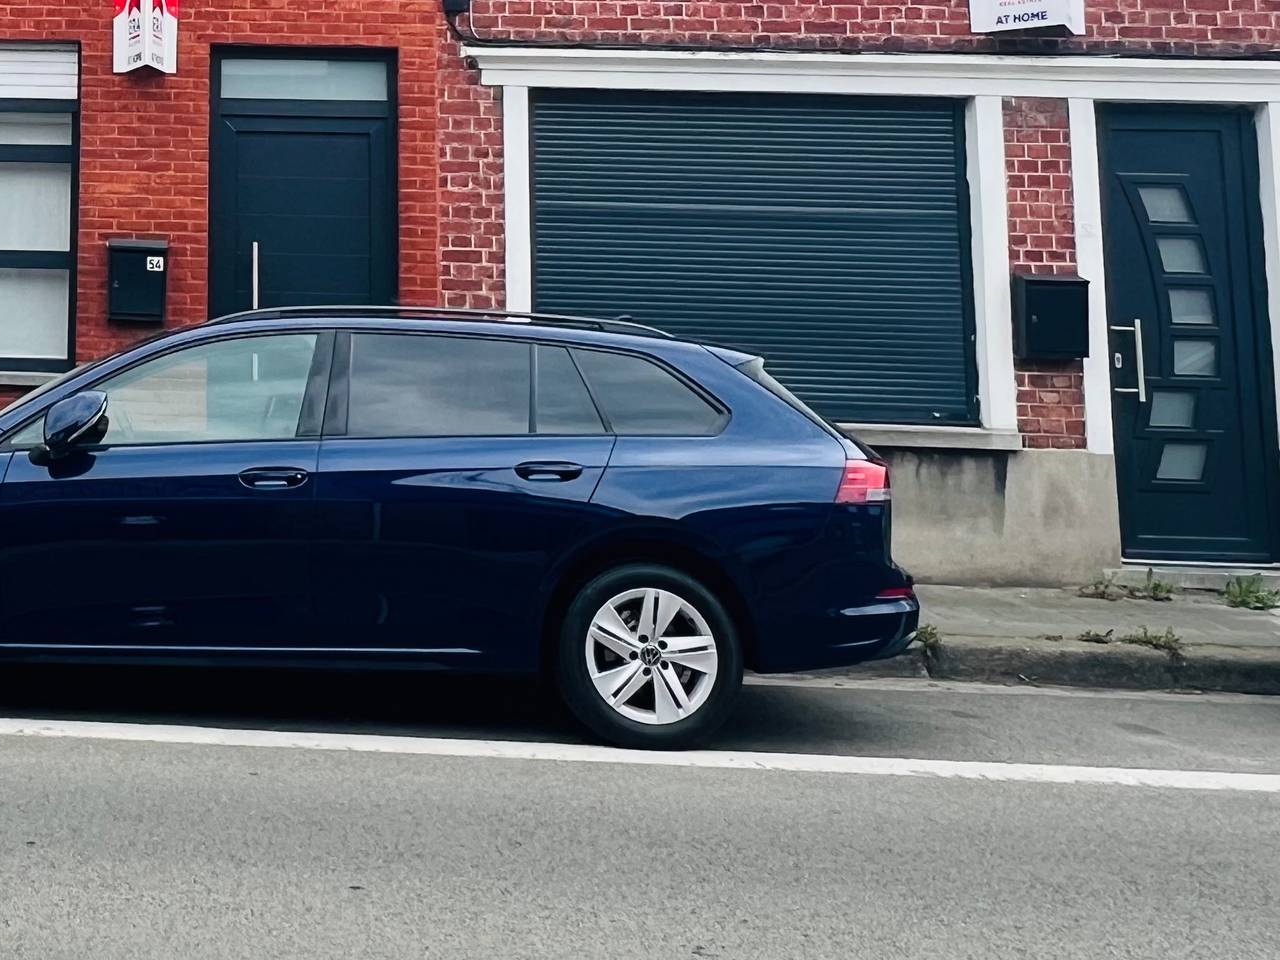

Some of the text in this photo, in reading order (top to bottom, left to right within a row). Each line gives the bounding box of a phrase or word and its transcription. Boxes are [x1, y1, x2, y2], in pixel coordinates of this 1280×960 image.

[996, 11, 1048, 25] AT HOME
[148, 259, 161, 270] 54
